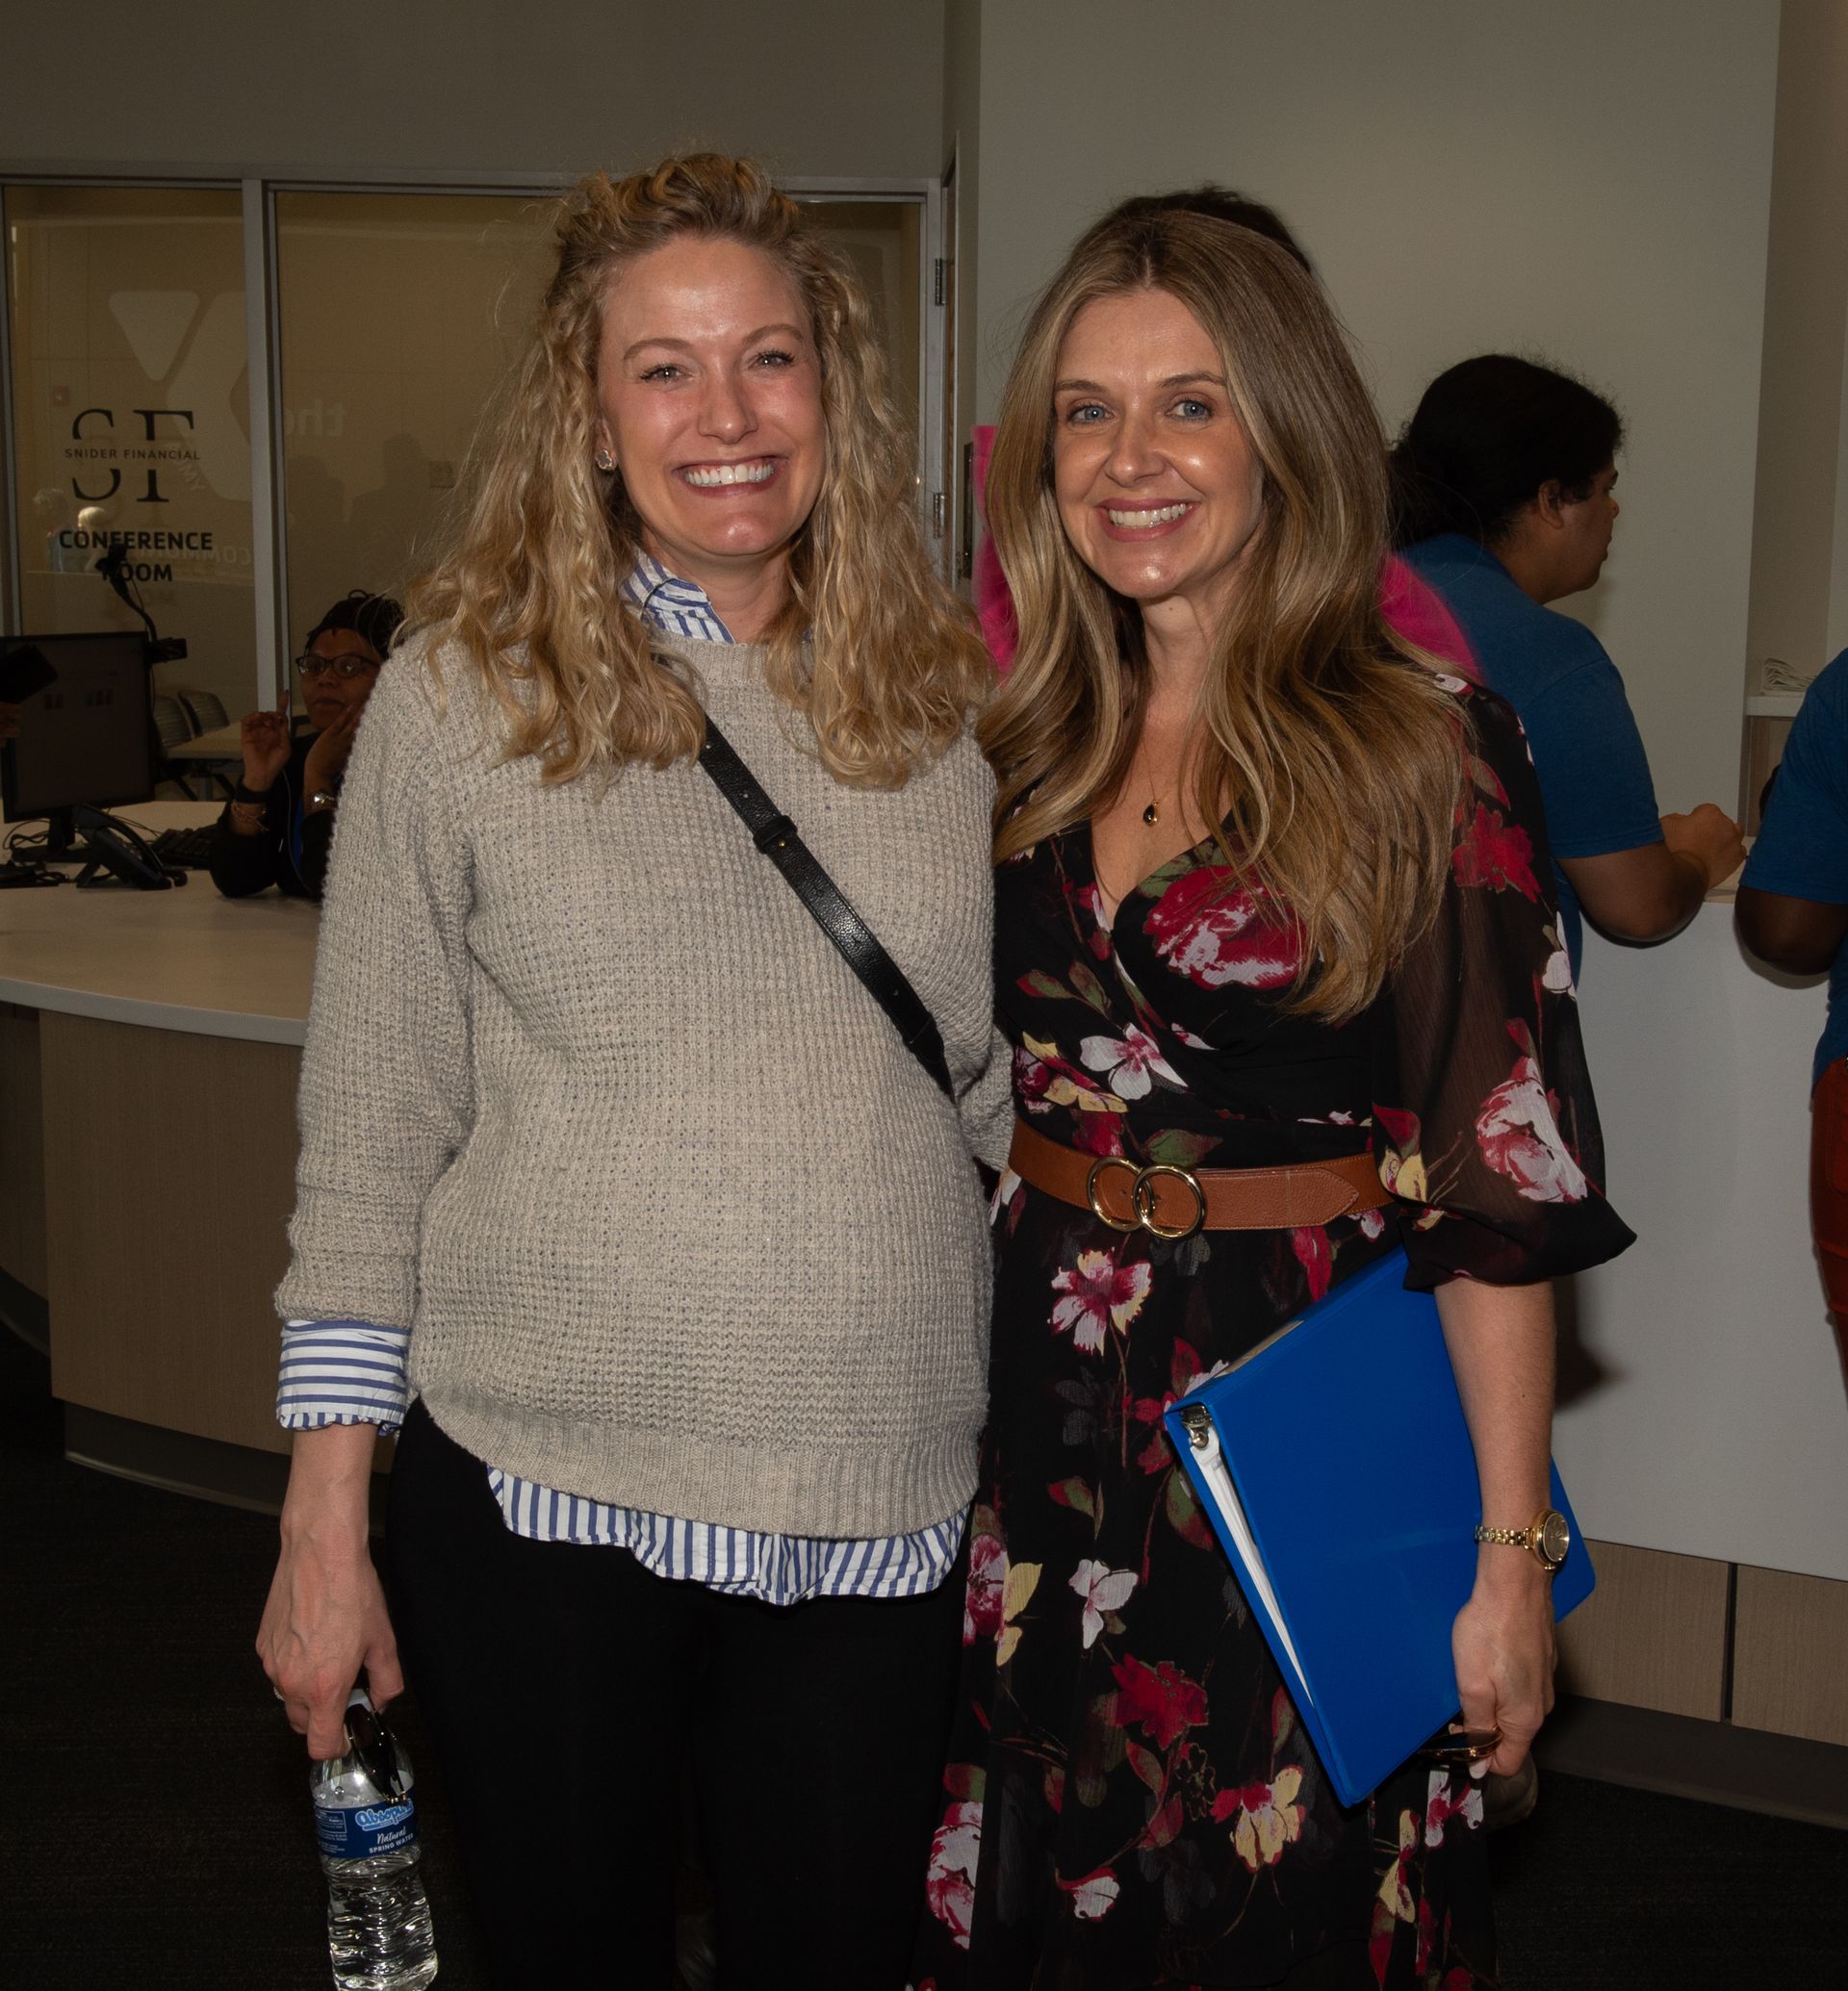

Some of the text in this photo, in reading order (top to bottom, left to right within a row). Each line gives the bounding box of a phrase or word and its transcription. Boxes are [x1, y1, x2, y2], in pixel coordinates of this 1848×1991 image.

[64, 448, 200, 460] SNIDER FINANCIAL
[59, 530, 213, 550] CONFERENCE
[369, 1833, 414, 1853] SPRING WATER
[376, 1826, 407, 1845] Natural
